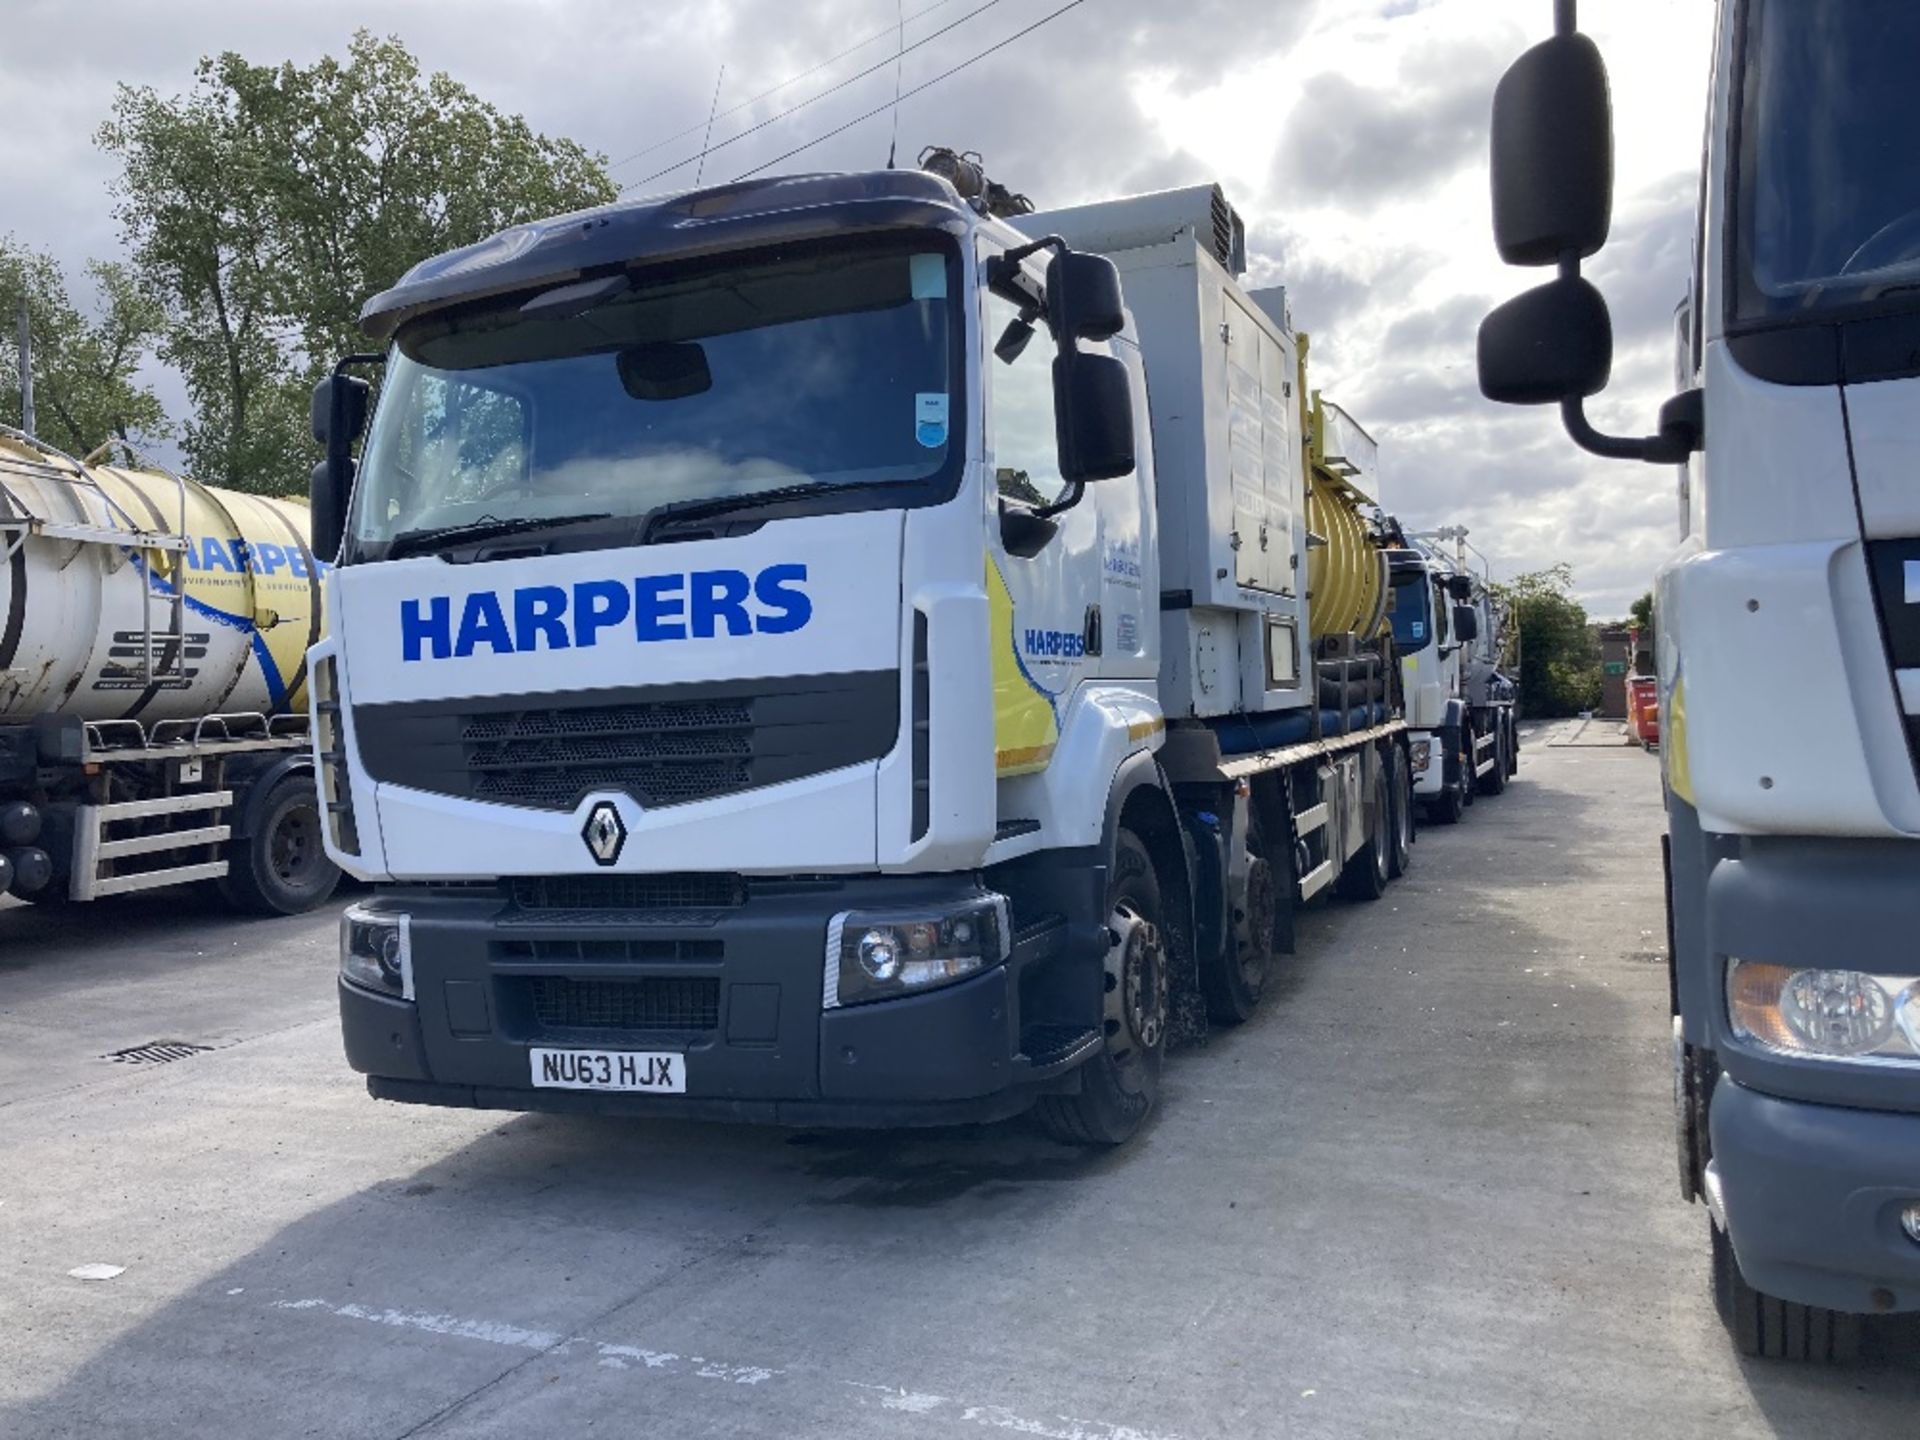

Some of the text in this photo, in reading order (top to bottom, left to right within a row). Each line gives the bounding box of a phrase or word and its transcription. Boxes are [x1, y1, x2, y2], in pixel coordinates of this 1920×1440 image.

[401, 563, 812, 662] HARPERS
[1024, 629, 1084, 657] HARPERS
[542, 1053, 673, 1087] NU63 HJX
